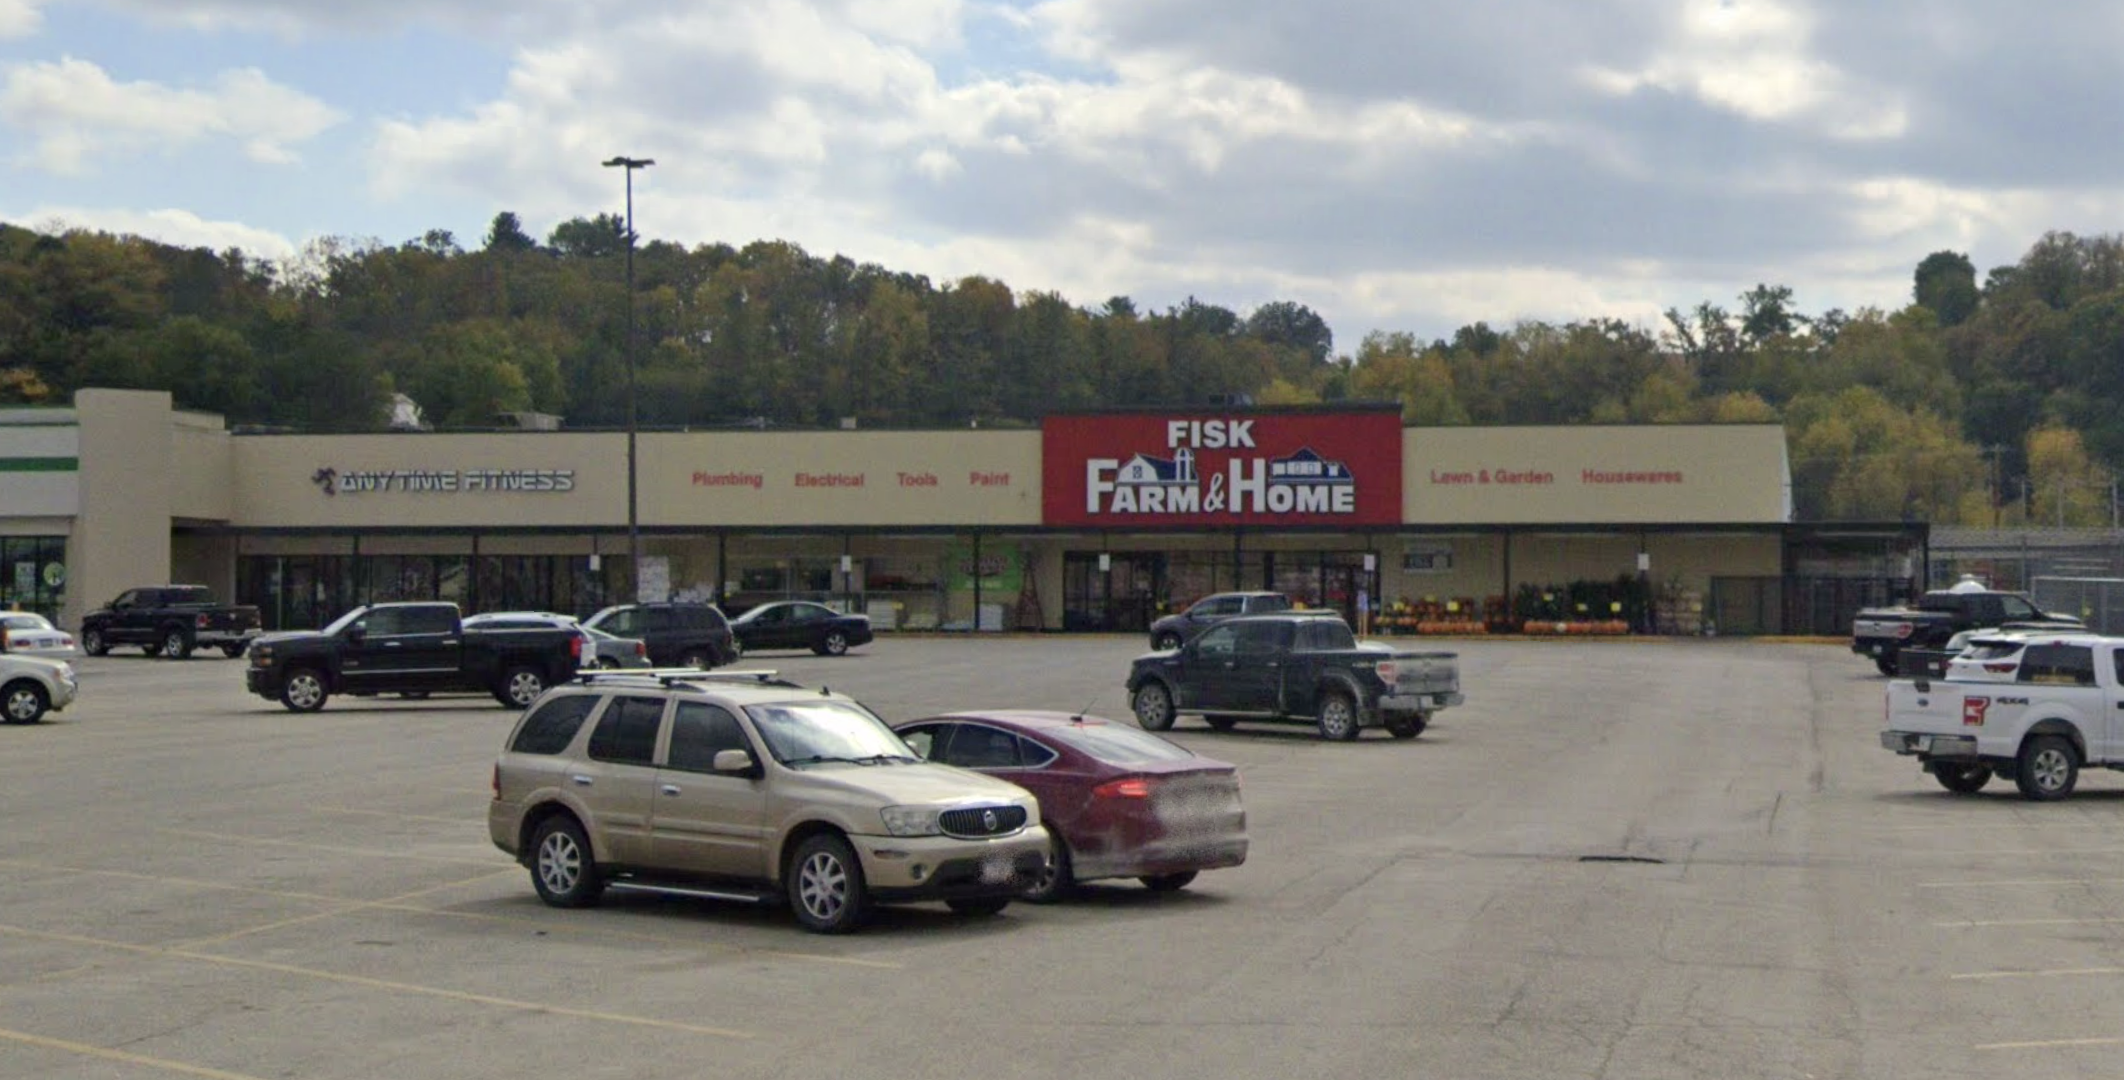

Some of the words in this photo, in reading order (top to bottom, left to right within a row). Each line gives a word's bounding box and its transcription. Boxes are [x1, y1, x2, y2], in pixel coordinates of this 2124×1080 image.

[1167, 420, 1256, 448] FISK
[340, 470, 457, 491] ANYTIME
[464, 470, 575, 491] FITNESS
[692, 472, 763, 488] Plumbing
[794, 472, 865, 487] Electrical
[897, 472, 938, 486] Tools
[969, 471, 1010, 486] Paint
[1431, 469, 1474, 484] Lawn
[1478, 469, 1490, 484] &
[1495, 469, 1554, 484] Garden
[1582, 469, 1683, 484] Housewares
[1086, 458, 1200, 513] FARM
[1203, 472, 1225, 512] &
[1229, 458, 1355, 513] HOME
